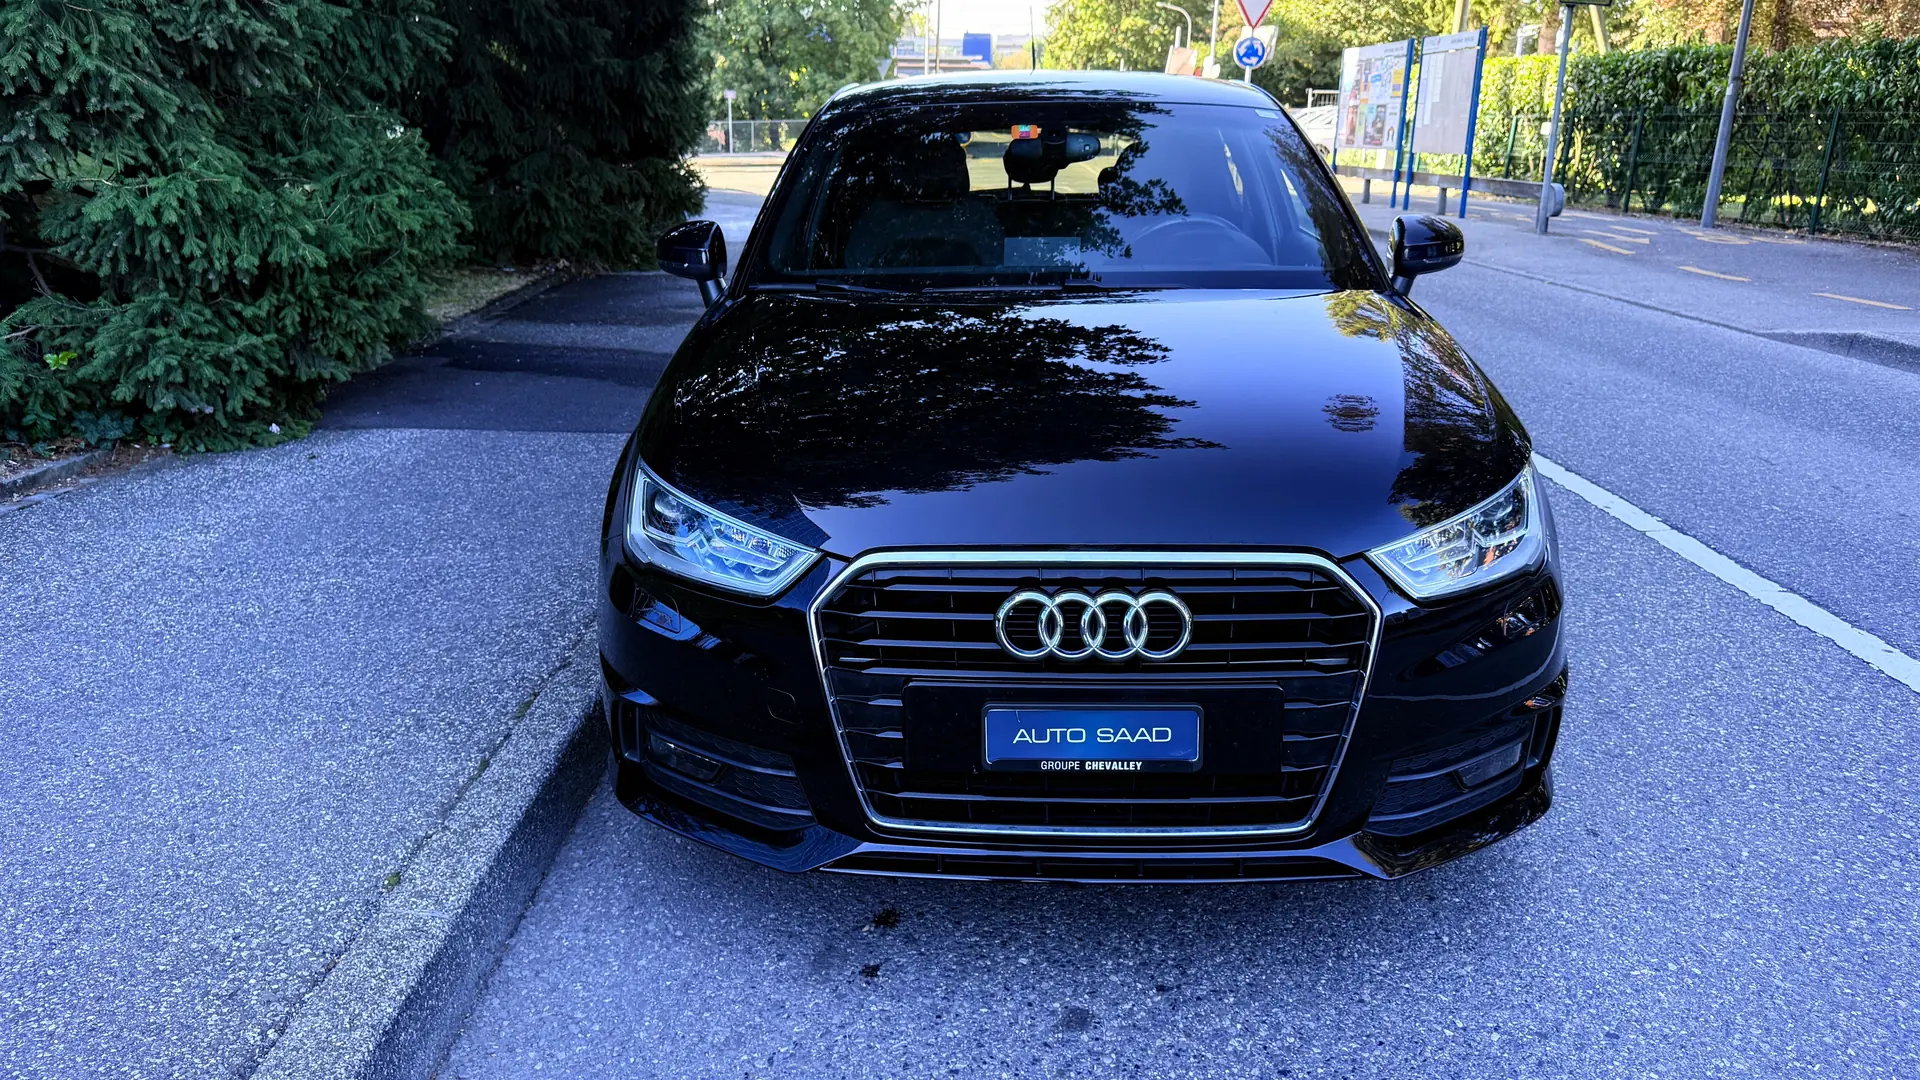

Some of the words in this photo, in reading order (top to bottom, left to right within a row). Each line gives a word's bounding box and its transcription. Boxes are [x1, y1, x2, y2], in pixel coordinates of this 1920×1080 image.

[1012, 727, 1086, 744] AUTO
[1096, 727, 1172, 743] SAAD
[1040, 760, 1081, 771] GROUPE
[1085, 760, 1143, 771] CHEVALLEY
